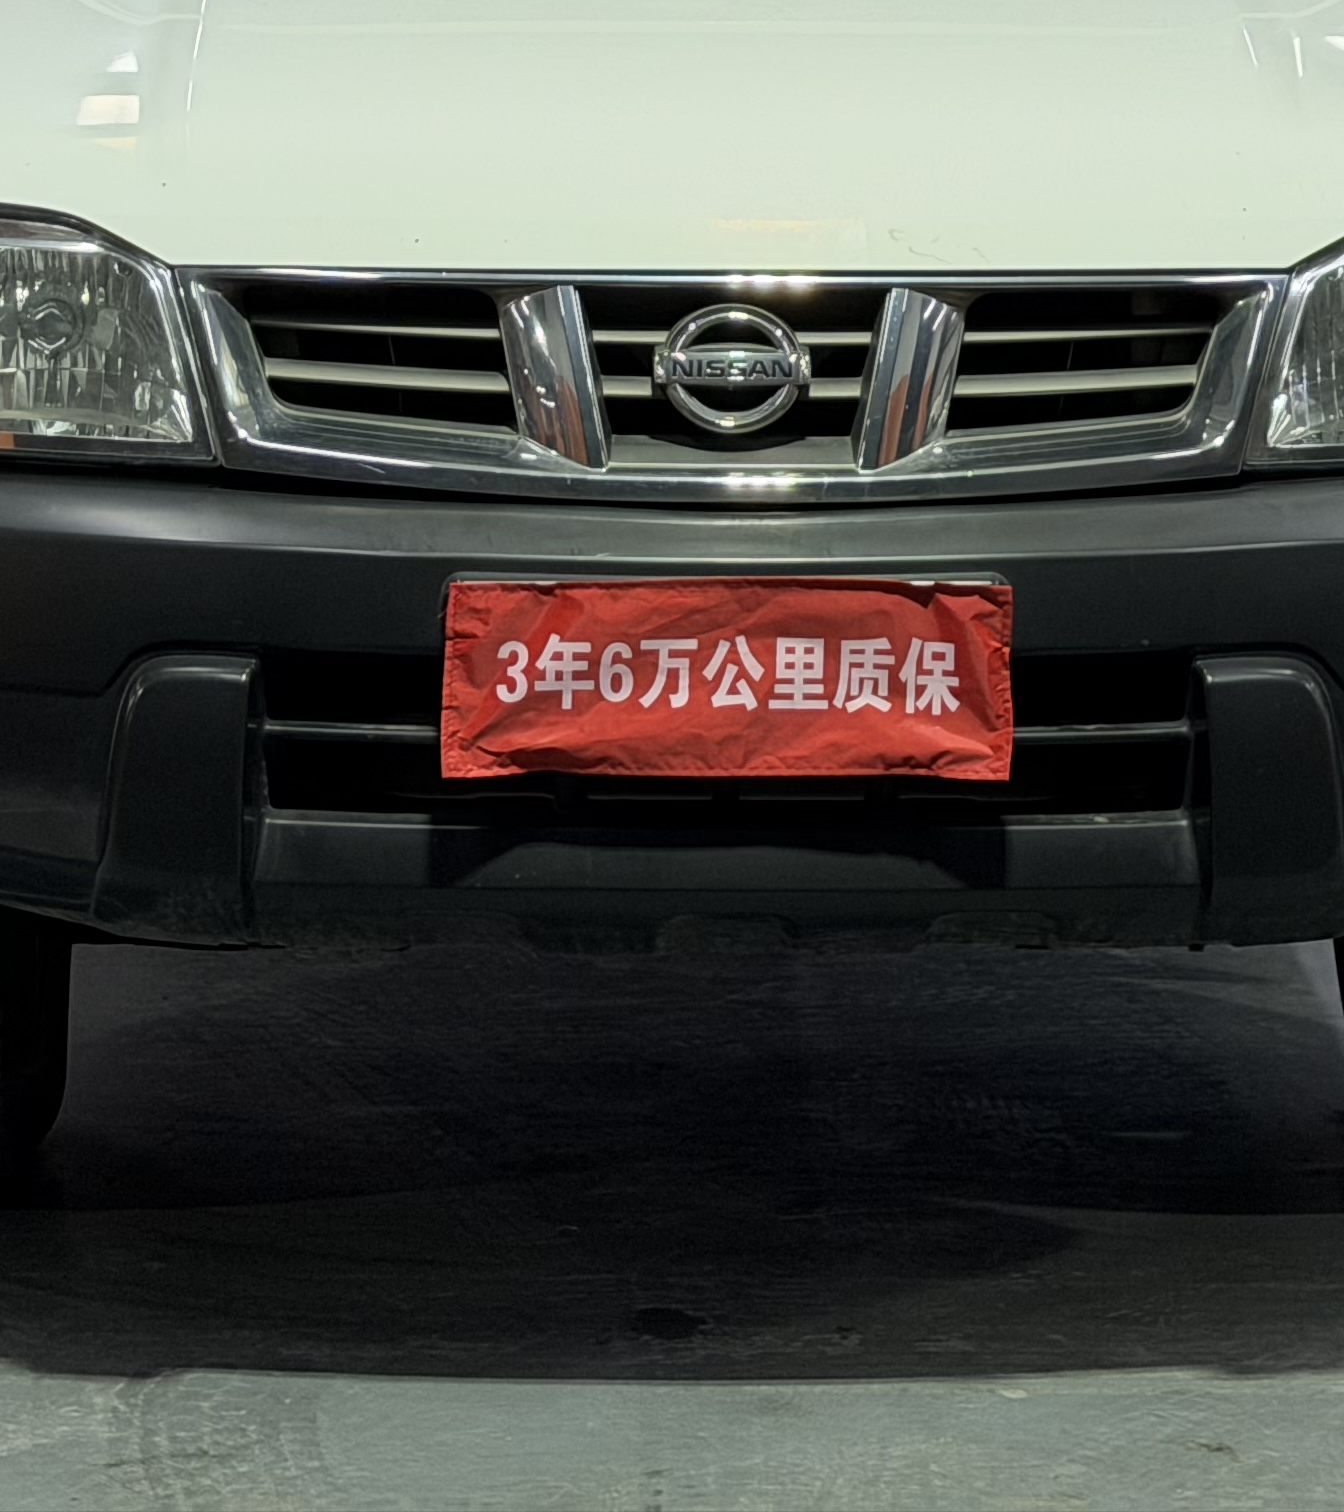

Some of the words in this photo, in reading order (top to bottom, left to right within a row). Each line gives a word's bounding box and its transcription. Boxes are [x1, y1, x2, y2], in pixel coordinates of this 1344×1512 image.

[671, 358, 794, 379] NISSAN
[494, 633, 961, 717] 3年6万公里质保
